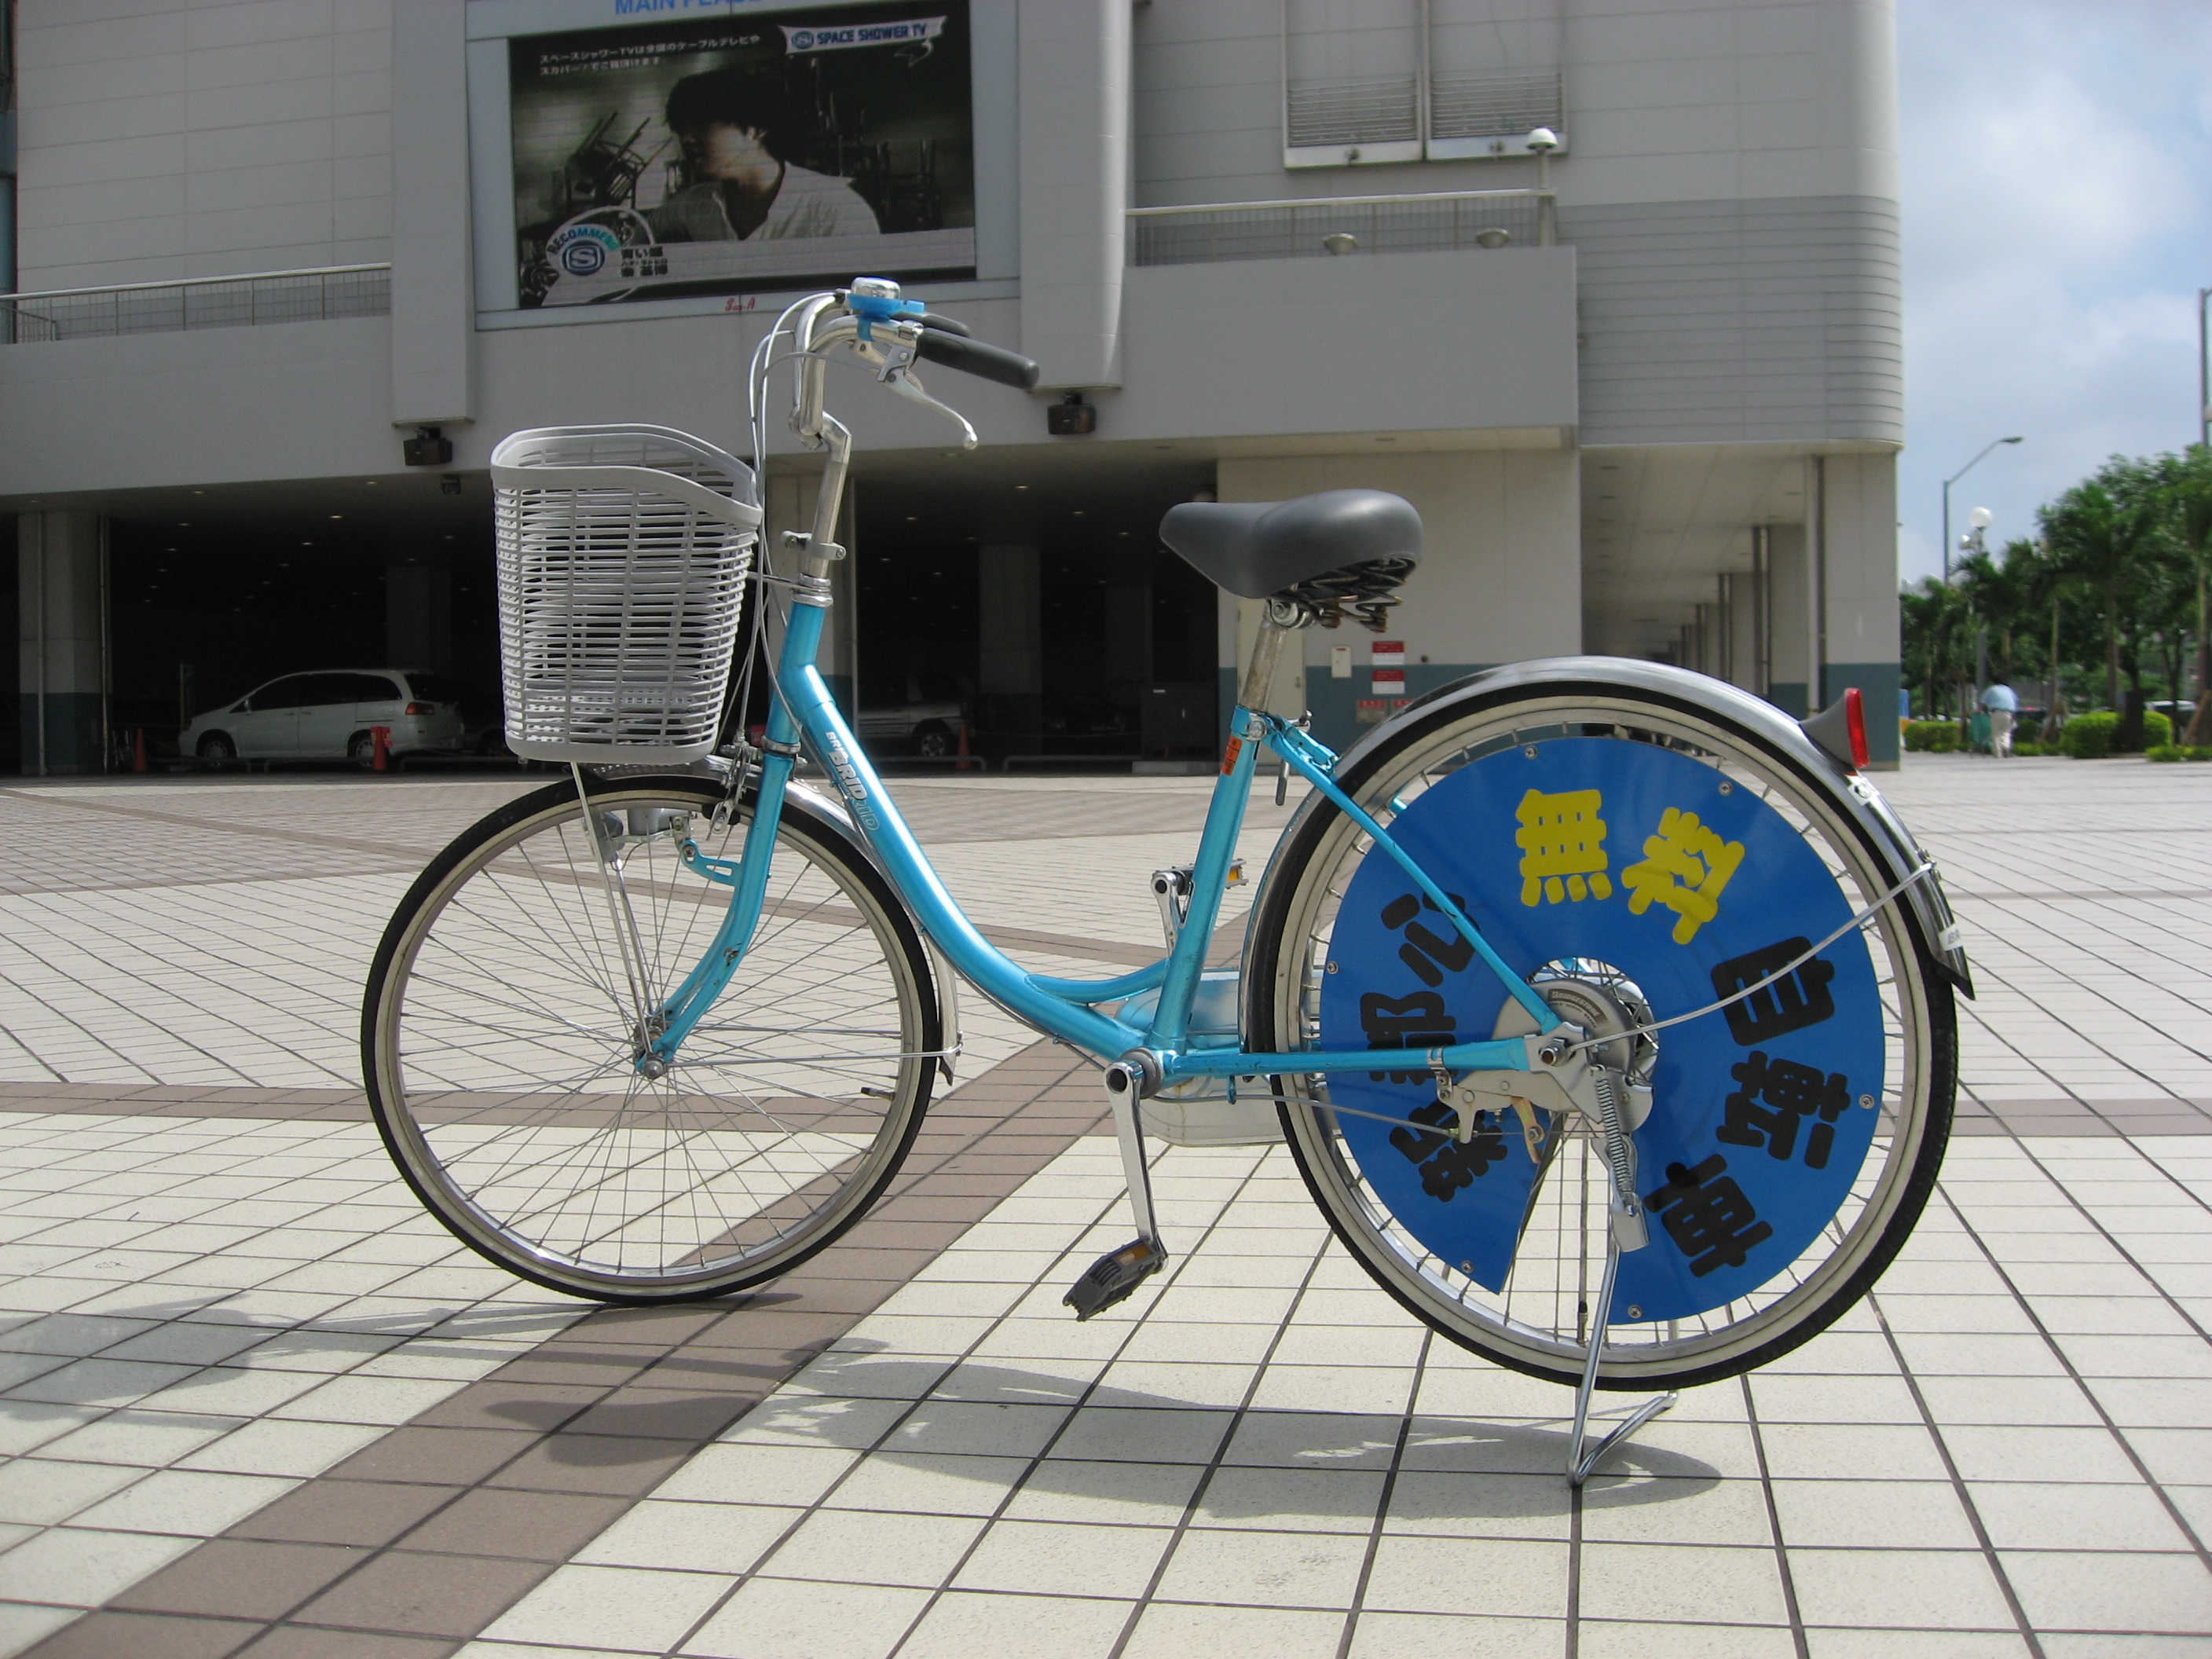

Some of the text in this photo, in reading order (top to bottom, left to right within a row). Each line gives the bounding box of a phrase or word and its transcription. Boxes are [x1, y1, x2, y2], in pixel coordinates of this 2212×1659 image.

[816, 24, 927, 45] SPACE SHOWER TV
[828, 751, 868, 801] BRID
[1514, 788, 1746, 945] 無料
[1645, 936, 1851, 1278] 自転車
